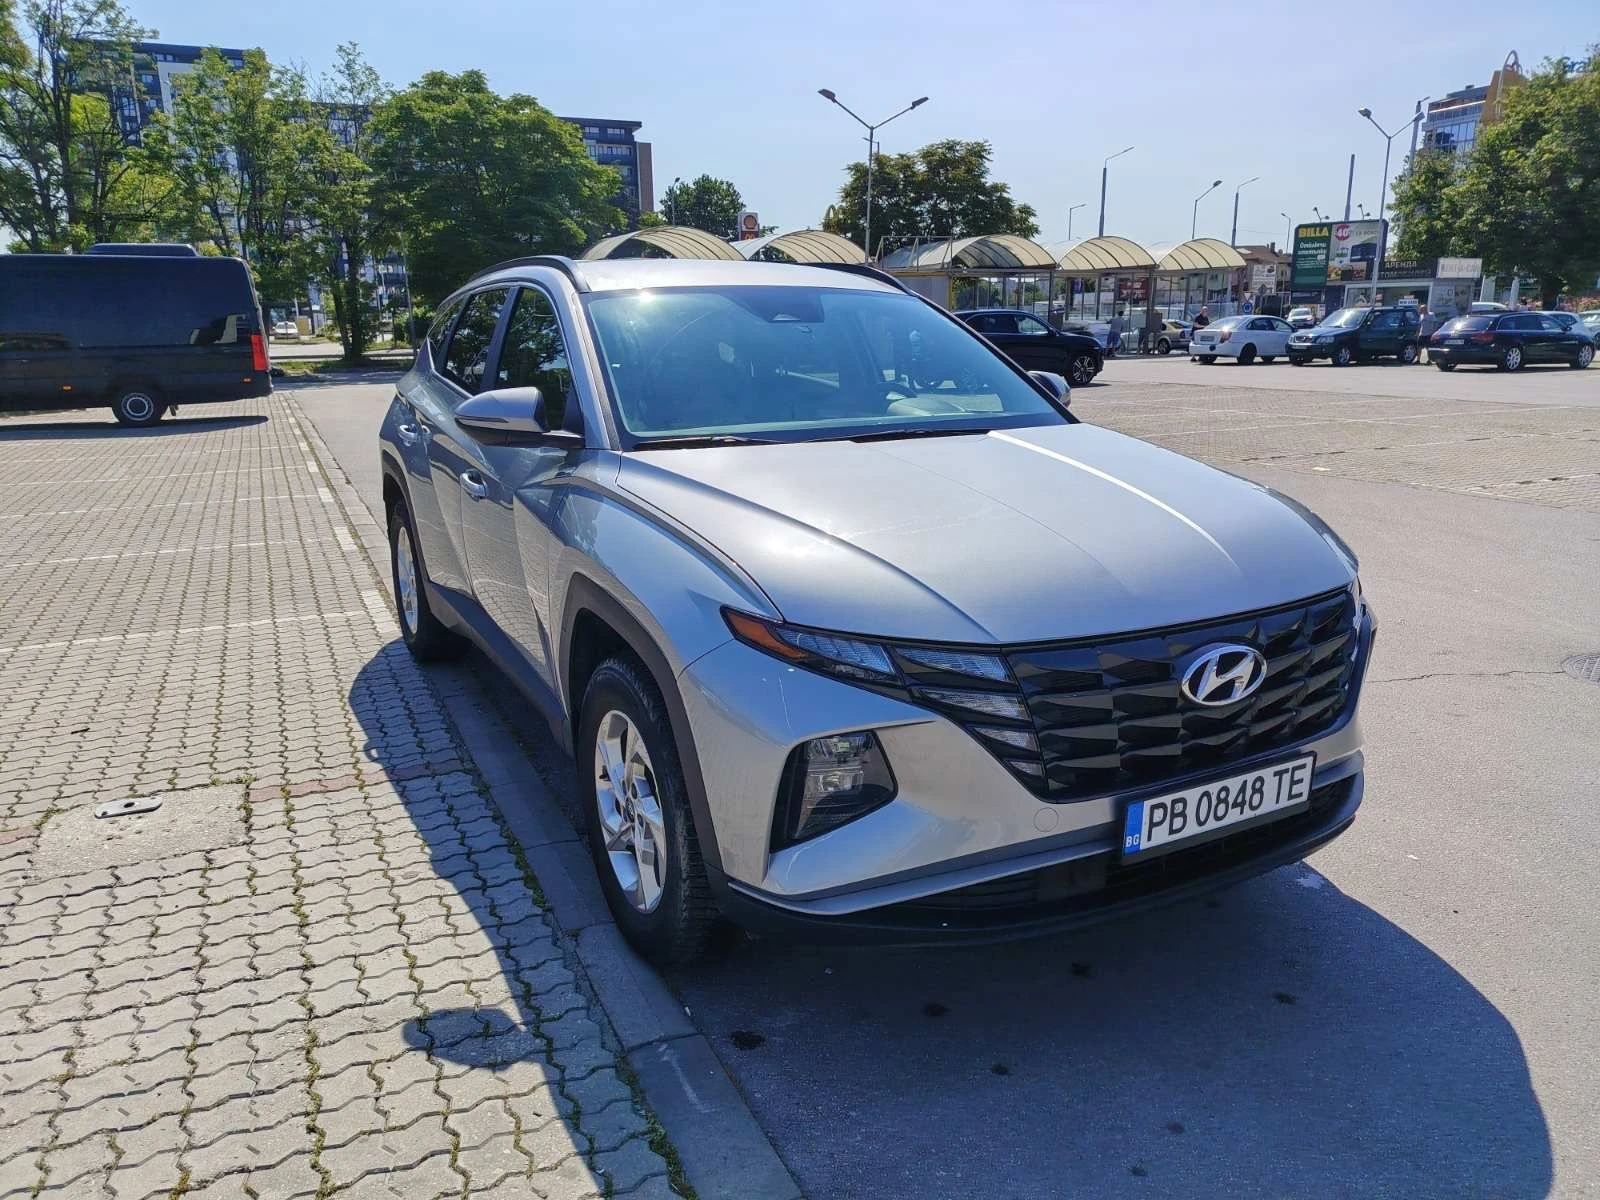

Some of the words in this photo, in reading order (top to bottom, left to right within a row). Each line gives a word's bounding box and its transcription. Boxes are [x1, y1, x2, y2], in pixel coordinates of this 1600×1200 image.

[1298, 226, 1329, 238] BILLA
[1147, 797, 1188, 842] PB
[1195, 775, 1265, 827] 0848
[1273, 763, 1306, 805] TE
[1126, 834, 1139, 848] BG
